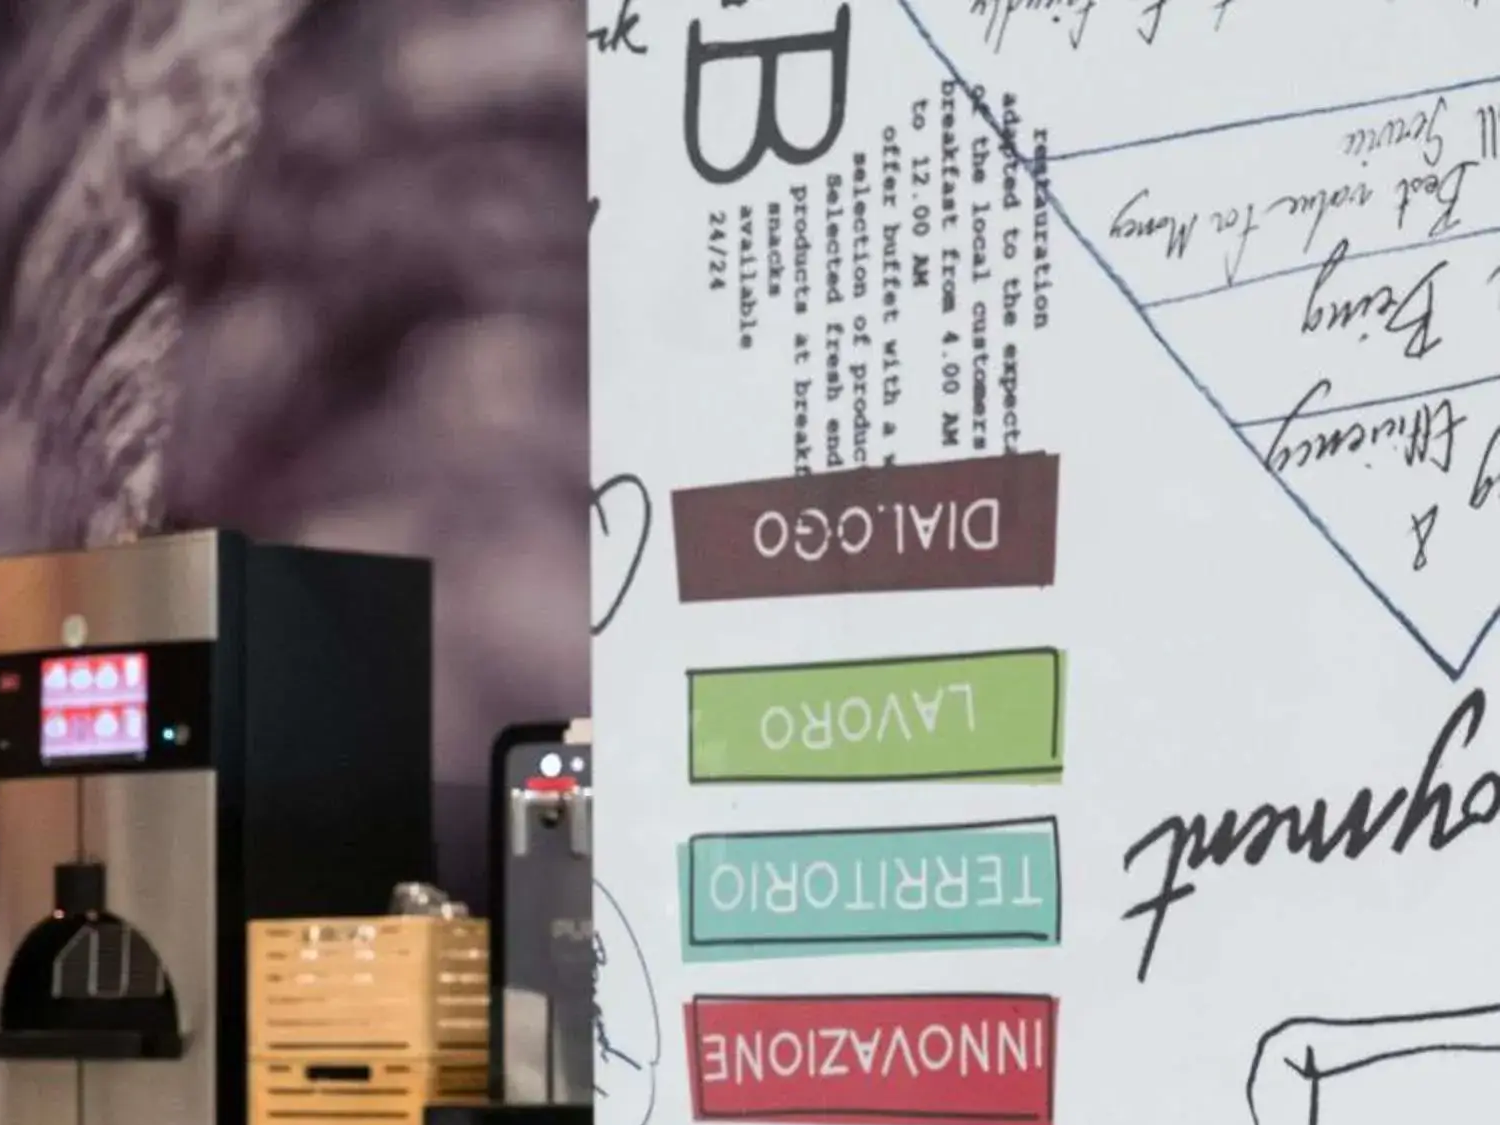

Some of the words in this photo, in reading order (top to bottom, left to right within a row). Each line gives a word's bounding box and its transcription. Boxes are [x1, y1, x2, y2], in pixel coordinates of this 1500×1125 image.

[912, 99, 929, 130] to
[998, 92, 1021, 210] adapted
[882, 126, 900, 207] offer
[941, 80, 959, 229] breakfast
[972, 136, 990, 183] the
[853, 152, 871, 298] selection
[912, 157, 930, 236] 12.00
[1032, 128, 1053, 330] restauration
[1109, 187, 1198, 260] Money
[1264, 181, 1375, 254] value
[1395, 161, 1480, 238] Best
[708, 212, 727, 290] 24/24
[739, 205, 757, 349] available
[768, 202, 784, 297] snacks
[789, 185, 811, 314] products
[826, 174, 843, 304] Selected
[882, 224, 901, 323] buffet
[912, 254, 929, 287] AM
[972, 203, 990, 283] local
[1002, 228, 1020, 259] to
[1210, 203, 1260, 288] for
[942, 249, 960, 313] from
[1002, 278, 1021, 326] the
[1300, 238, 1449, 360] Being
[794, 334, 810, 364] at
[826, 323, 843, 401] fresh
[853, 316, 870, 346] of
[942, 331, 960, 394] 4.00
[882, 340, 901, 405] with
[972, 301, 988, 450] customers
[848, 364, 870, 468] produc
[883, 422, 896, 436] a
[942, 412, 959, 446] AM
[1265, 379, 1467, 473] Efficiency
[753, 497, 1000, 561] DIALOGO
[759, 681, 976, 751] LAVORO
[709, 855, 1043, 912] TERRITORIO
[701, 1017, 1044, 1085] INNOVAZIONE
